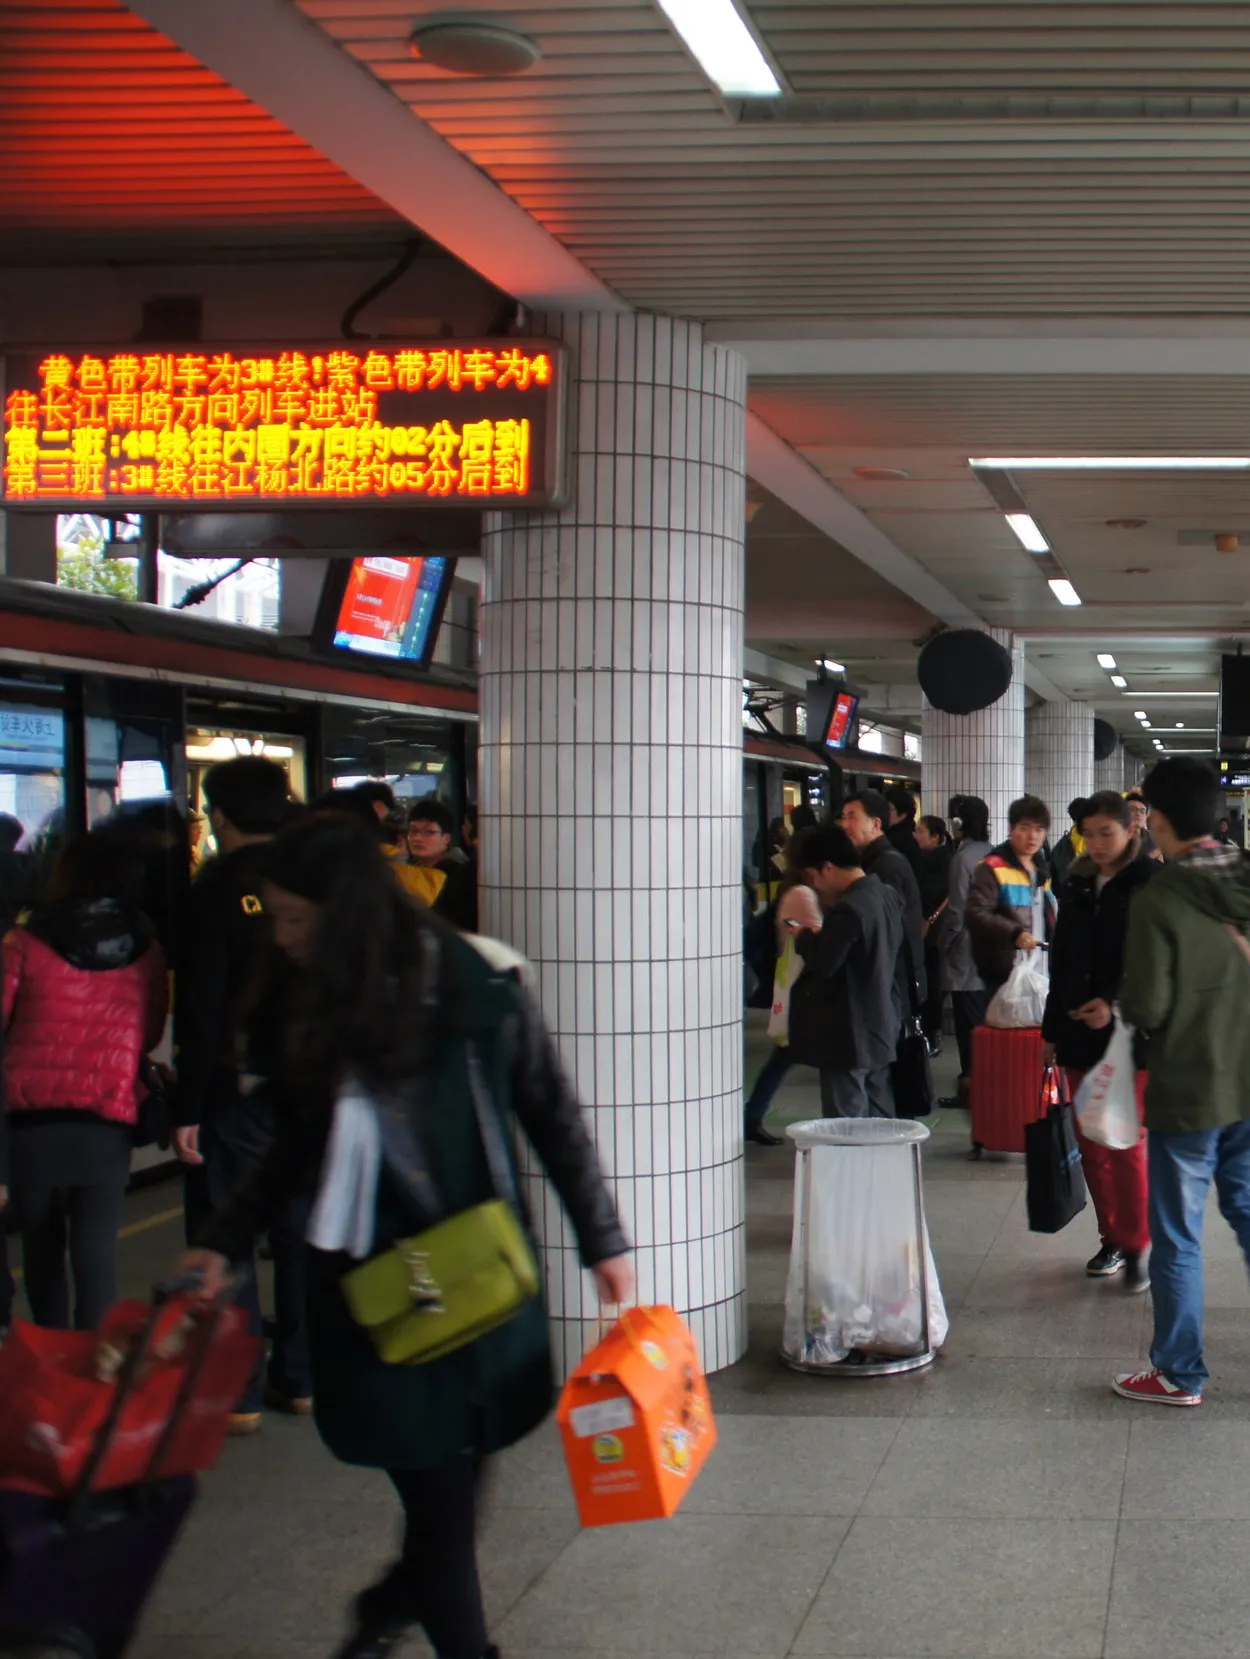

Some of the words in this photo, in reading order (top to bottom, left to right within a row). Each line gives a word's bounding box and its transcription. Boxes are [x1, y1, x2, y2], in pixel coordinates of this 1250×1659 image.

[6, 386, 376, 429] 往长江南路方向列车进站
